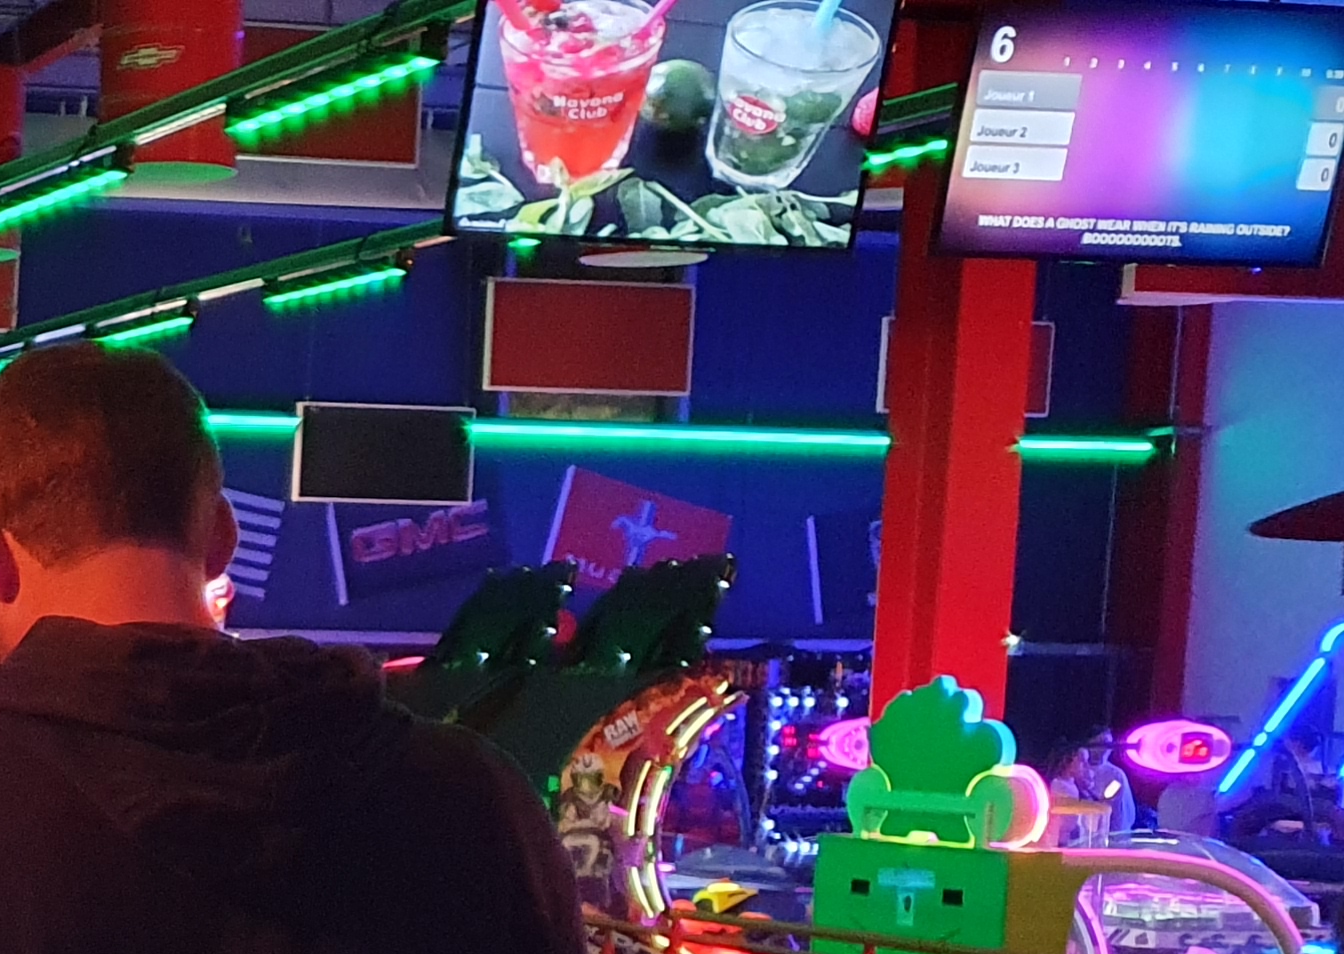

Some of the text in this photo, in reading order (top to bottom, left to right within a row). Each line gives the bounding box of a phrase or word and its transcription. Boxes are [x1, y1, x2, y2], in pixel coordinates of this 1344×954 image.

[990, 25, 1017, 63] 6
[553, 91, 624, 107] Havana
[568, 107, 608, 119] Club
[976, 125, 1338, 149] Joueur 2 0
[969, 160, 1330, 183] Joueur 3 0
[978, 214, 1012, 227] WHAT
[1012, 215, 1044, 228] DOES
[1045, 217, 1054, 229] A
[1056, 217, 1096, 230] GHOST
[351, 499, 489, 563] GMC
